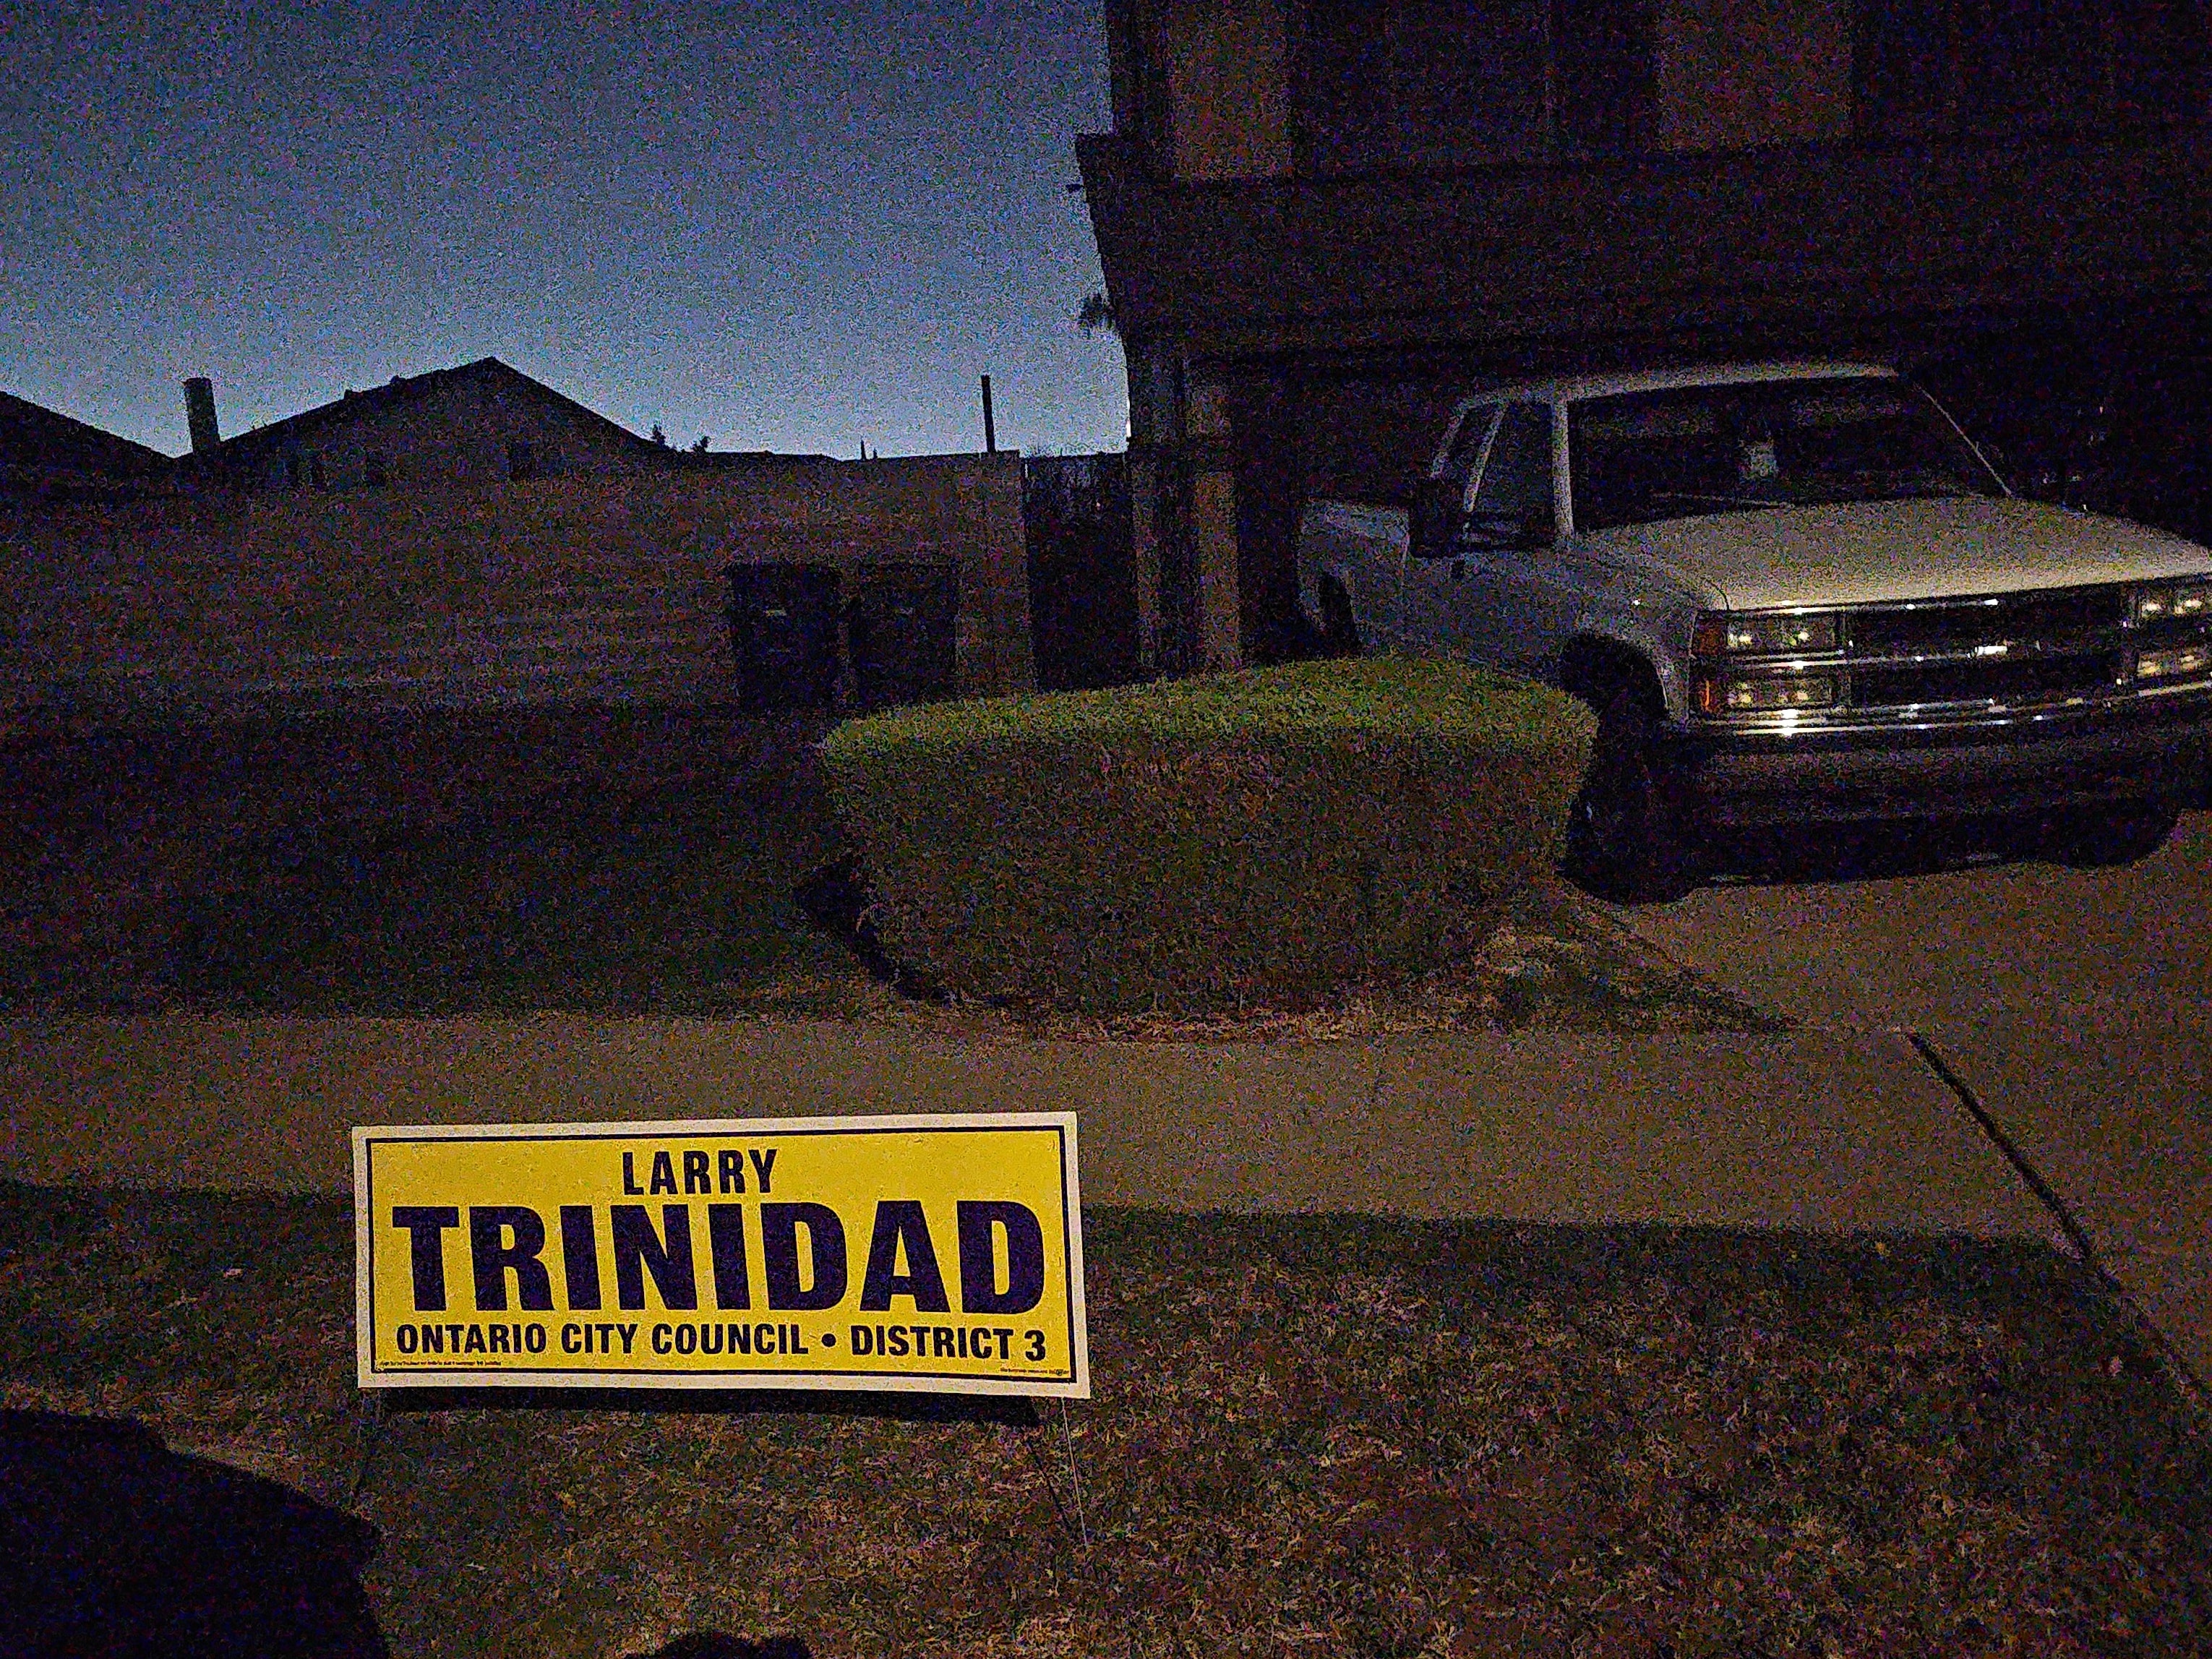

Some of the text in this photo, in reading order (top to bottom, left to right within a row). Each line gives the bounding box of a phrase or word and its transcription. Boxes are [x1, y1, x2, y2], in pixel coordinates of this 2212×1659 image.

[623, 1149, 777, 1195] LARRY
[393, 1201, 1045, 1314] TRINIDAD
[396, 1324, 1045, 1361] ONTARIO CITY COUNCIL DISTRICT 3
